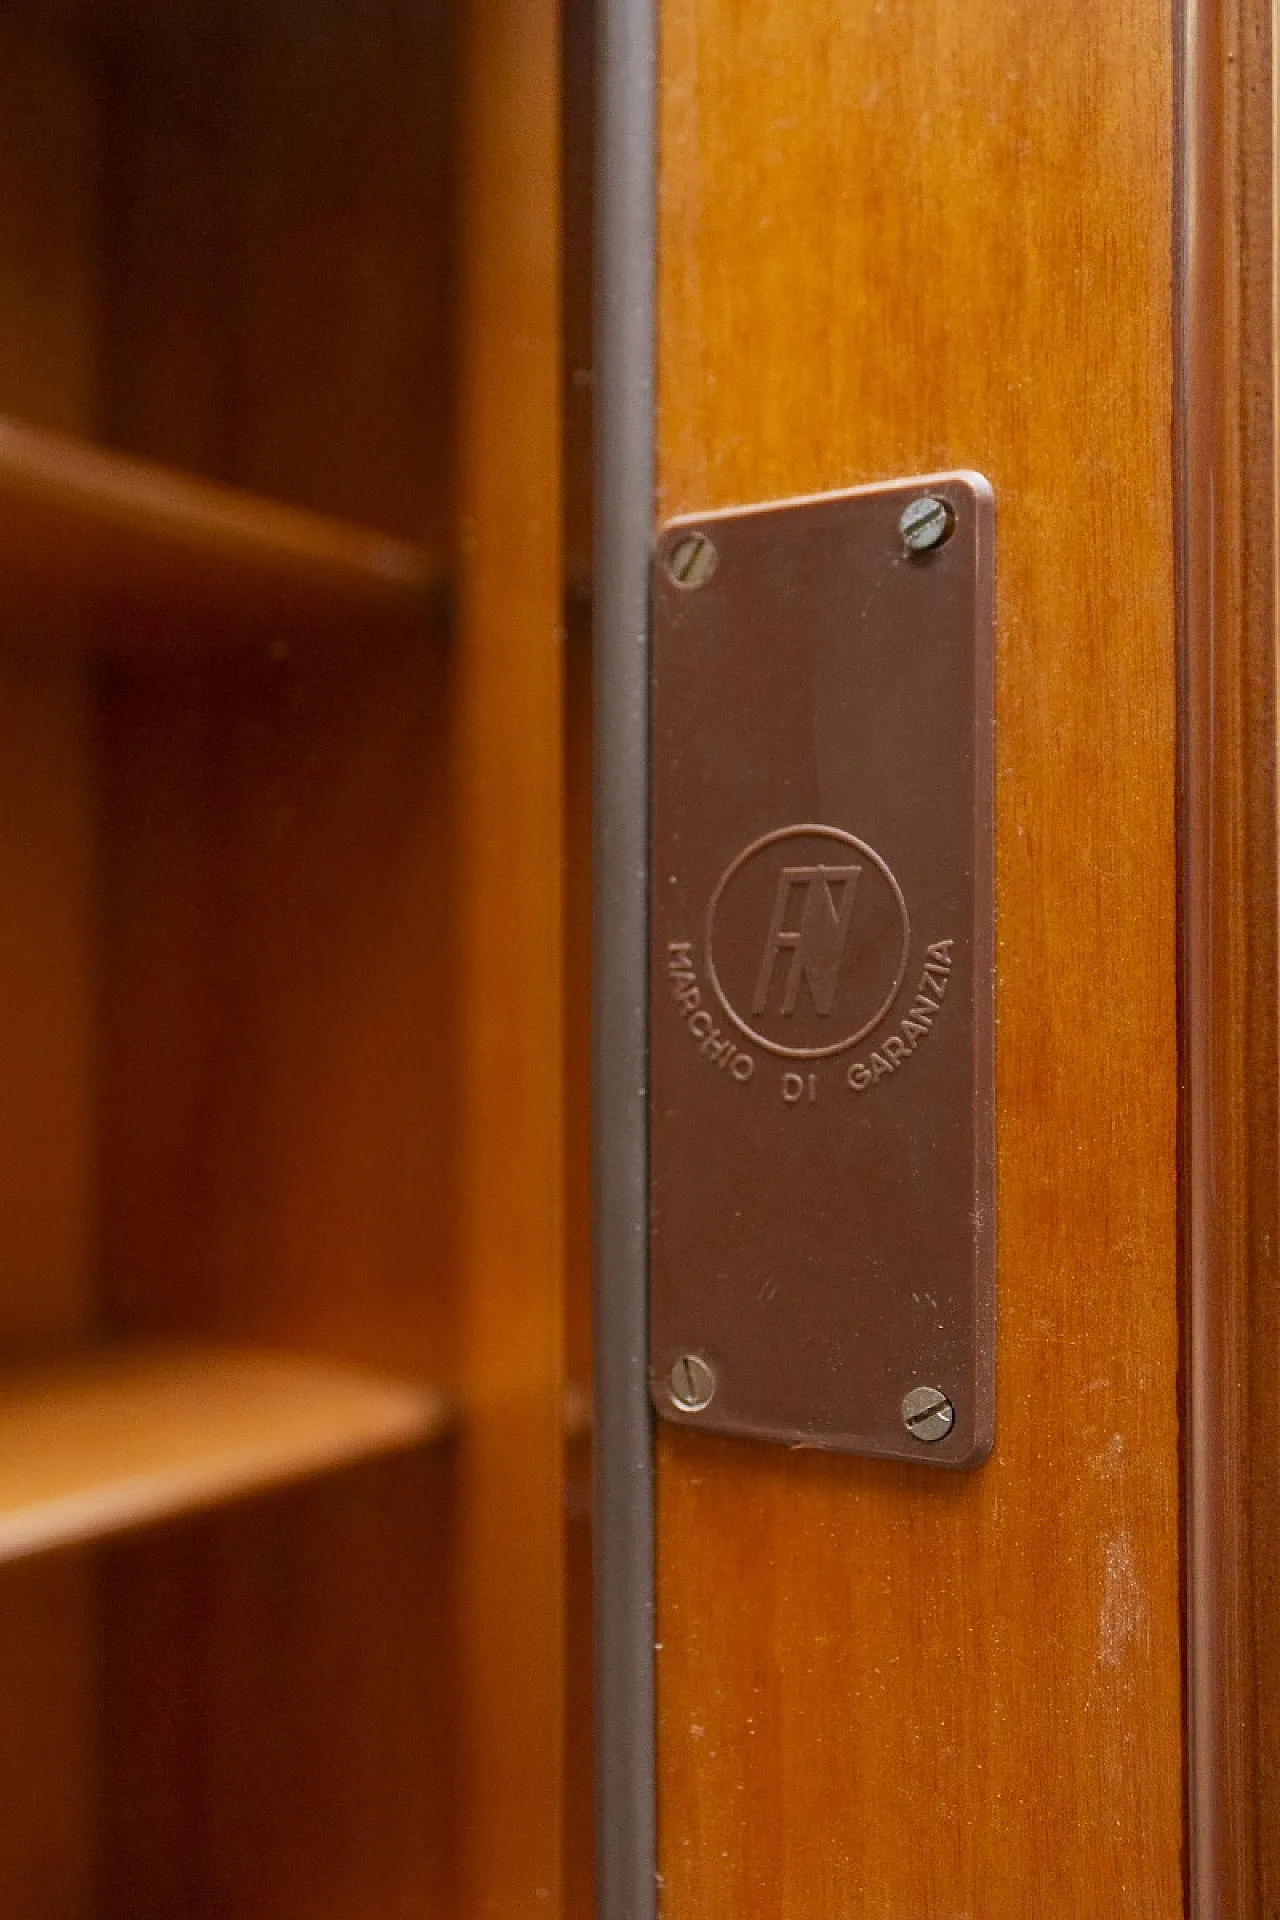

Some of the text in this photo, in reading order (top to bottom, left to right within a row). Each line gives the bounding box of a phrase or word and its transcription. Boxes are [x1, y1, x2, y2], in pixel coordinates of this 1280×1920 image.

[668, 939, 954, 1102] MARCHIO DI GARANZIA
